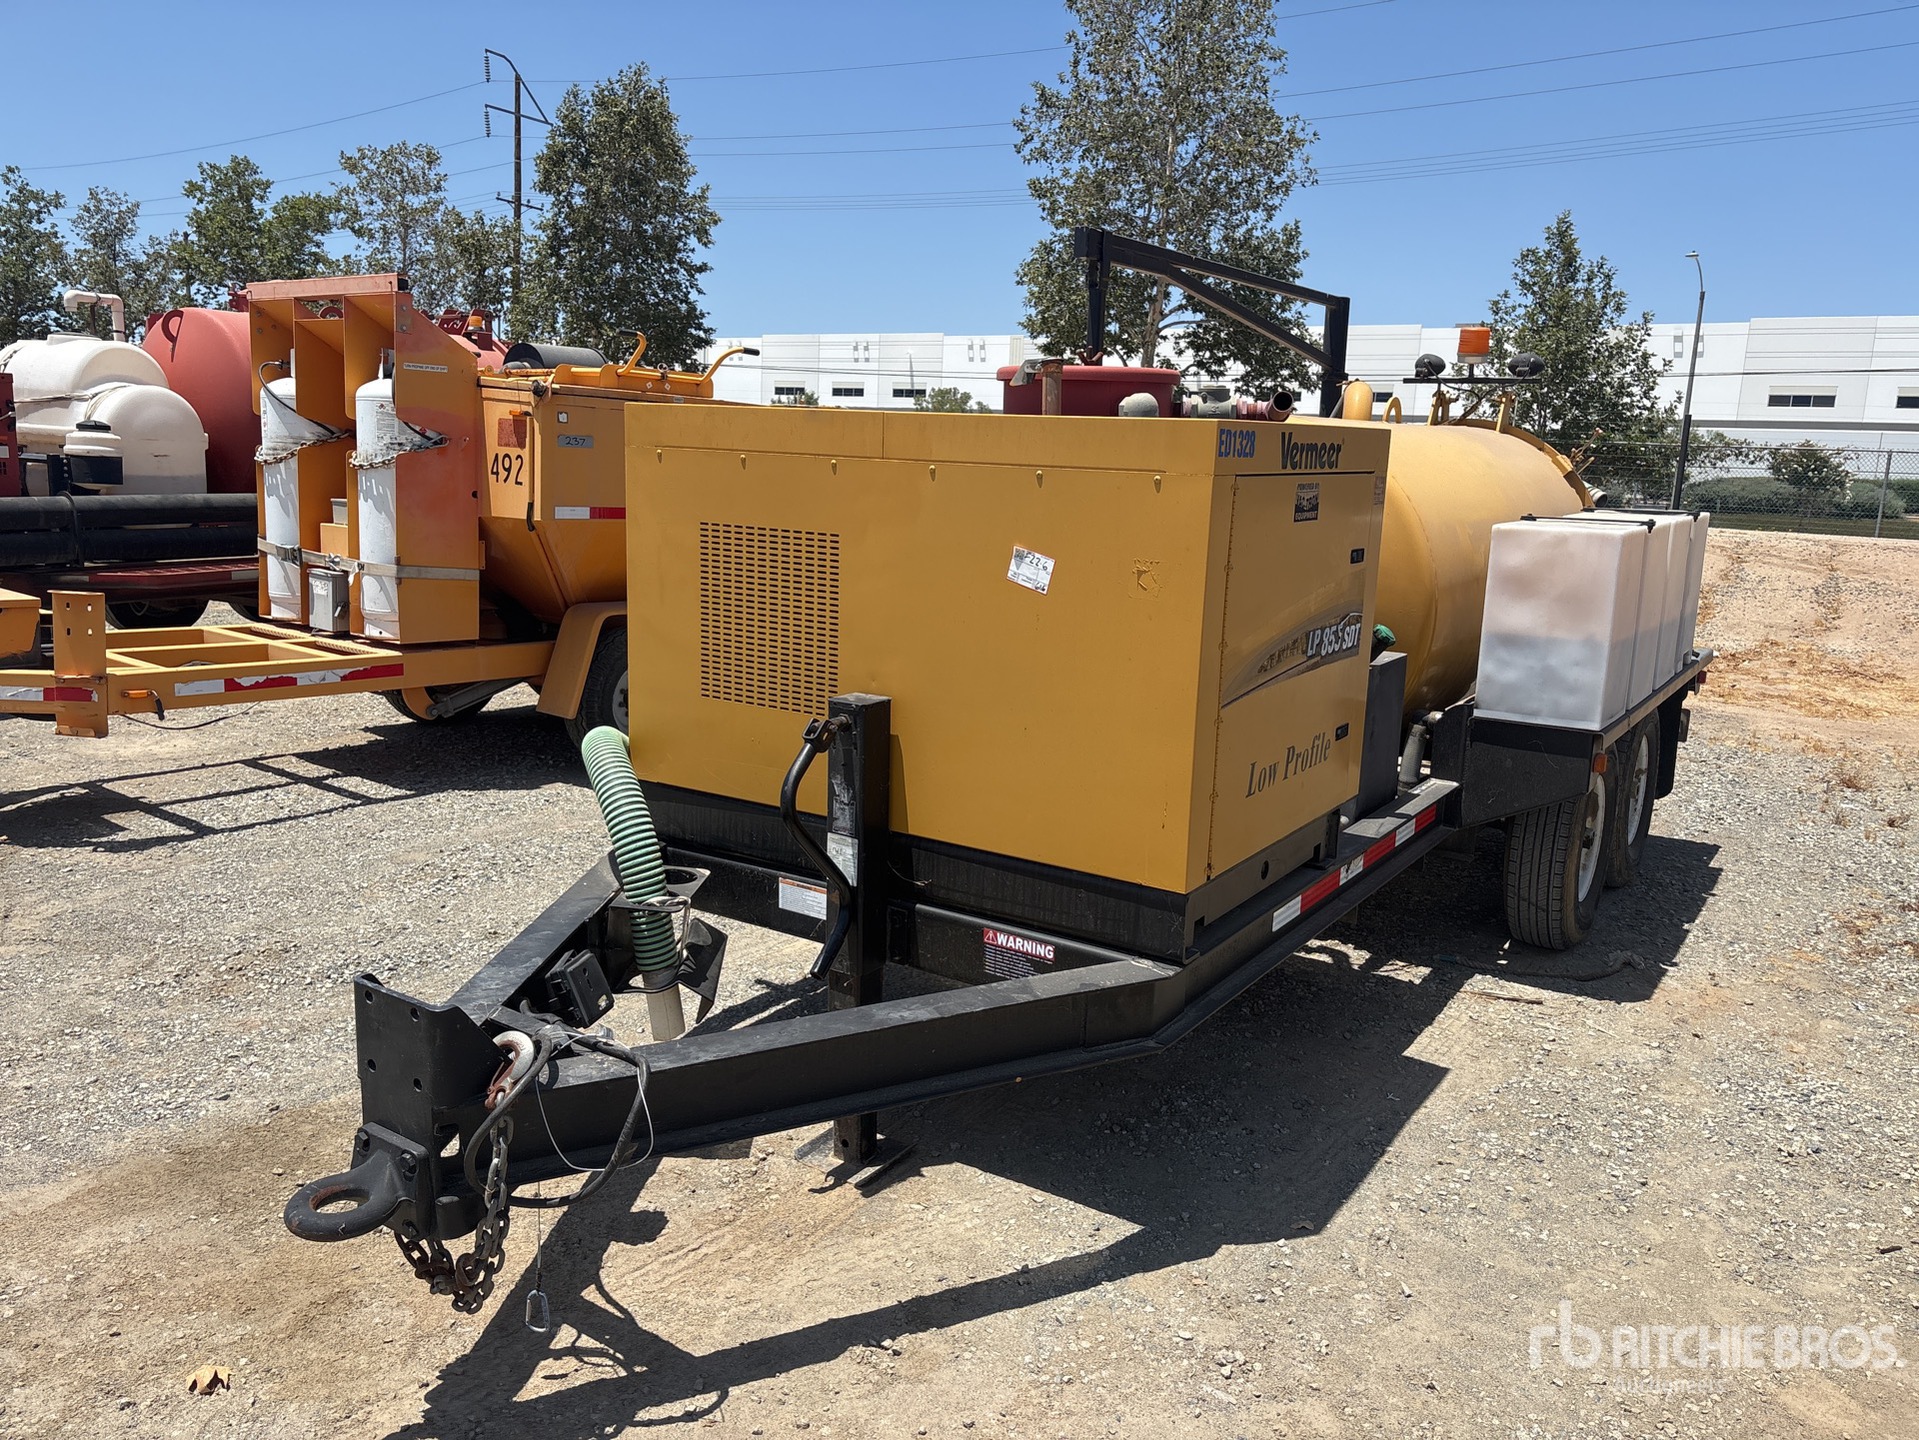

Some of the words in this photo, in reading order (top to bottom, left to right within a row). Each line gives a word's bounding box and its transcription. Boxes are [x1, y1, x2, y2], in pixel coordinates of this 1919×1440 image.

[565, 436, 586, 446] 237
[1218, 429, 1256, 458] ED1328
[1280, 432, 1342, 470] Vermeer
[491, 453, 524, 486] 492
[1307, 629, 1321, 657] LP
[1321, 625, 1343, 656] 855
[1342, 623, 1361, 649] SDT
[1245, 760, 1279, 799] Low
[1282, 732, 1331, 781] Profile
[996, 932, 1055, 959] WARNING
